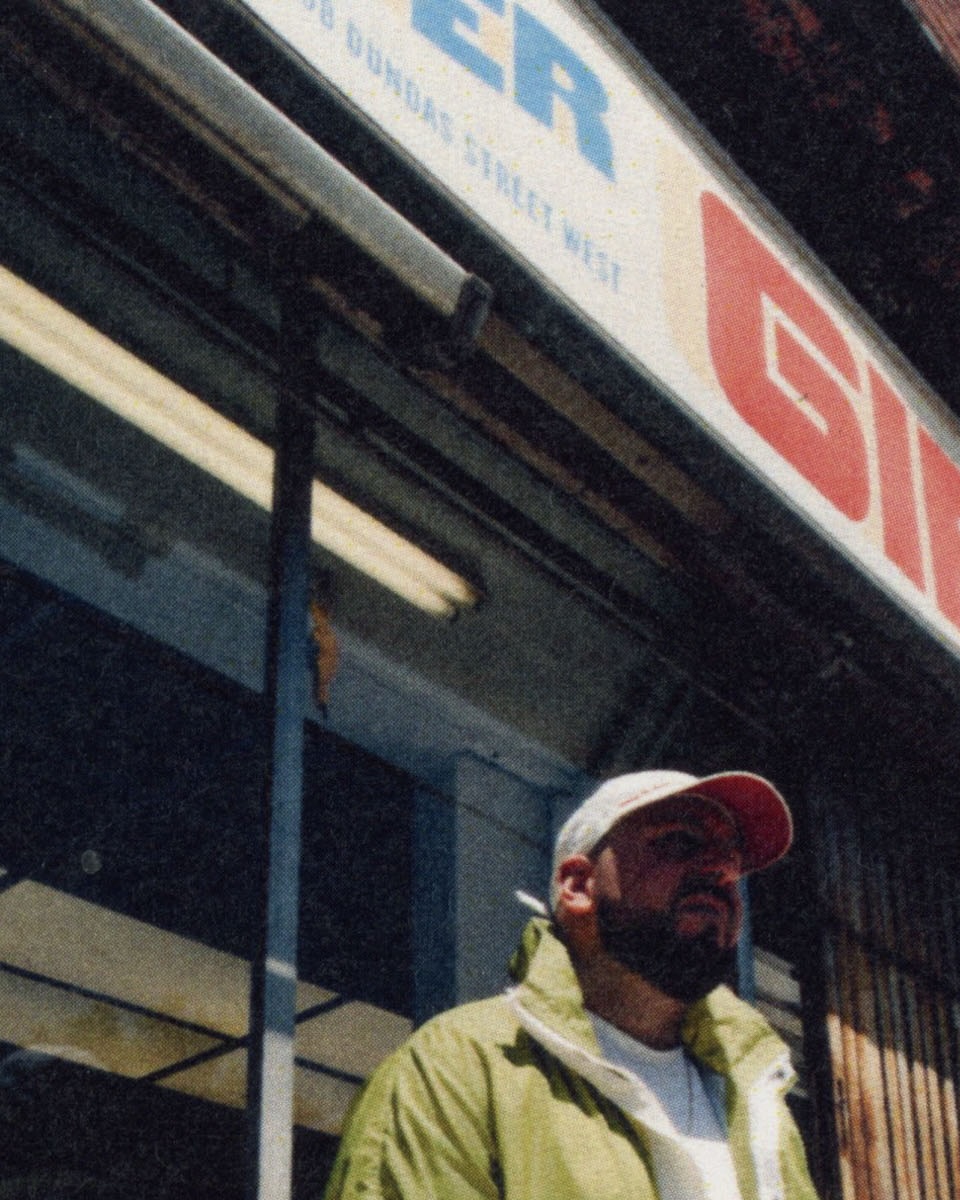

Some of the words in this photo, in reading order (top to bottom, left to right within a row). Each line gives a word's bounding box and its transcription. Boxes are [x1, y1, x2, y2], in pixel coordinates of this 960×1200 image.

[346, 19, 453, 144] DUNDAS
[464, 130, 552, 231] STREET
[563, 218, 621, 293] WEST
